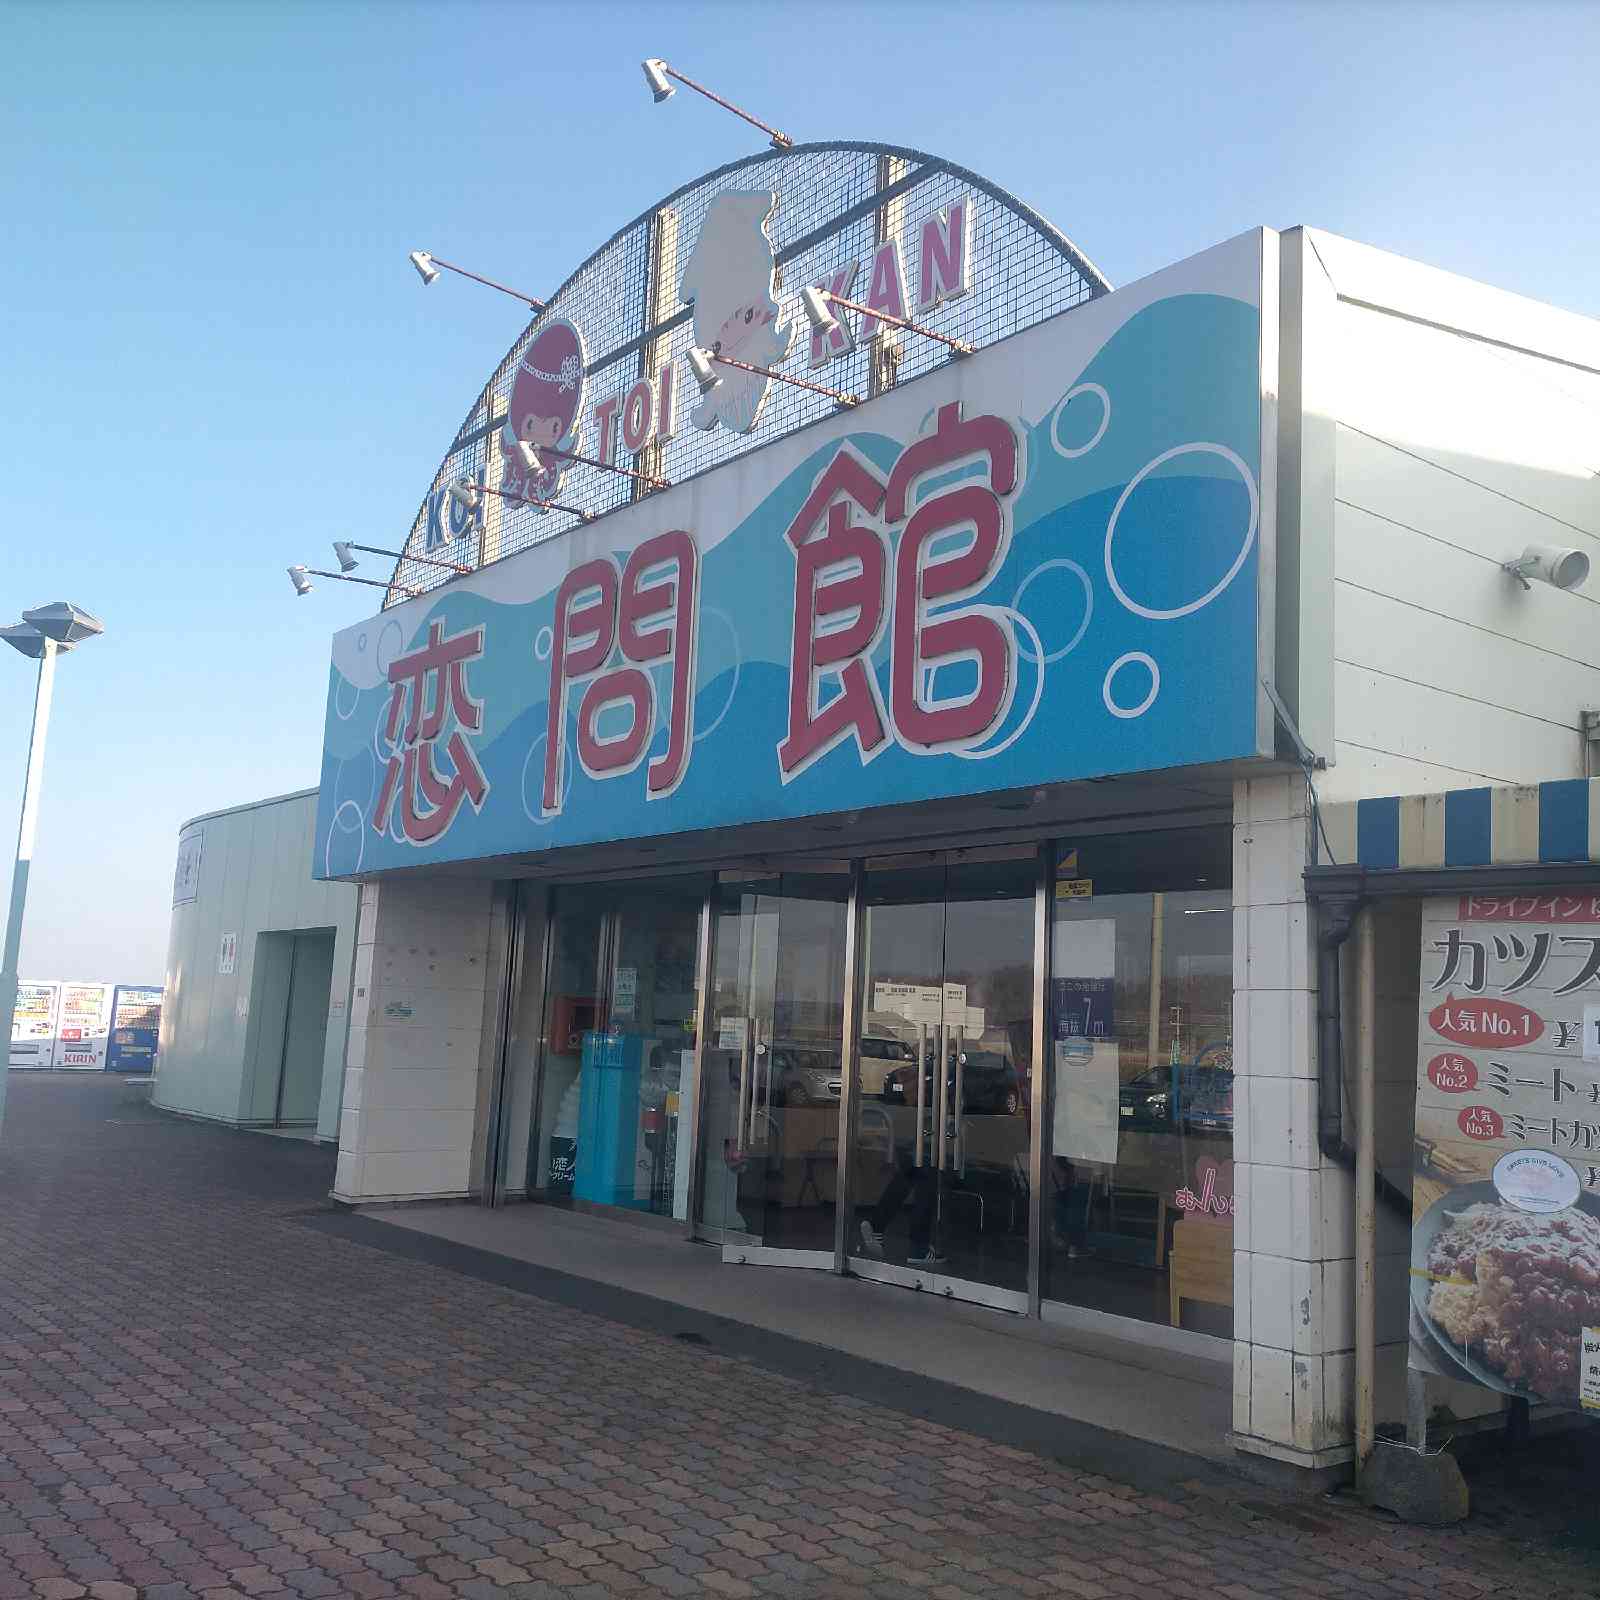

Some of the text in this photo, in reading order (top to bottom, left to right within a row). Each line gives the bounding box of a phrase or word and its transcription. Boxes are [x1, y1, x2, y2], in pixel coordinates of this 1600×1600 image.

[594, 363, 678, 471] TOI
[805, 197, 972, 370] KAN
[372, 400, 1022, 846] 恋問館
[1437, 1009, 1531, 1035] 人気No.1
[64, 1054, 97, 1064] KIRIN
[1439, 1057, 1464, 1073] 人気
[1436, 1073, 1468, 1088] No.2
[1488, 1062, 1576, 1102] ミート
[1469, 1108, 1492, 1122] 人気
[1466, 1123, 1494, 1137] No.3
